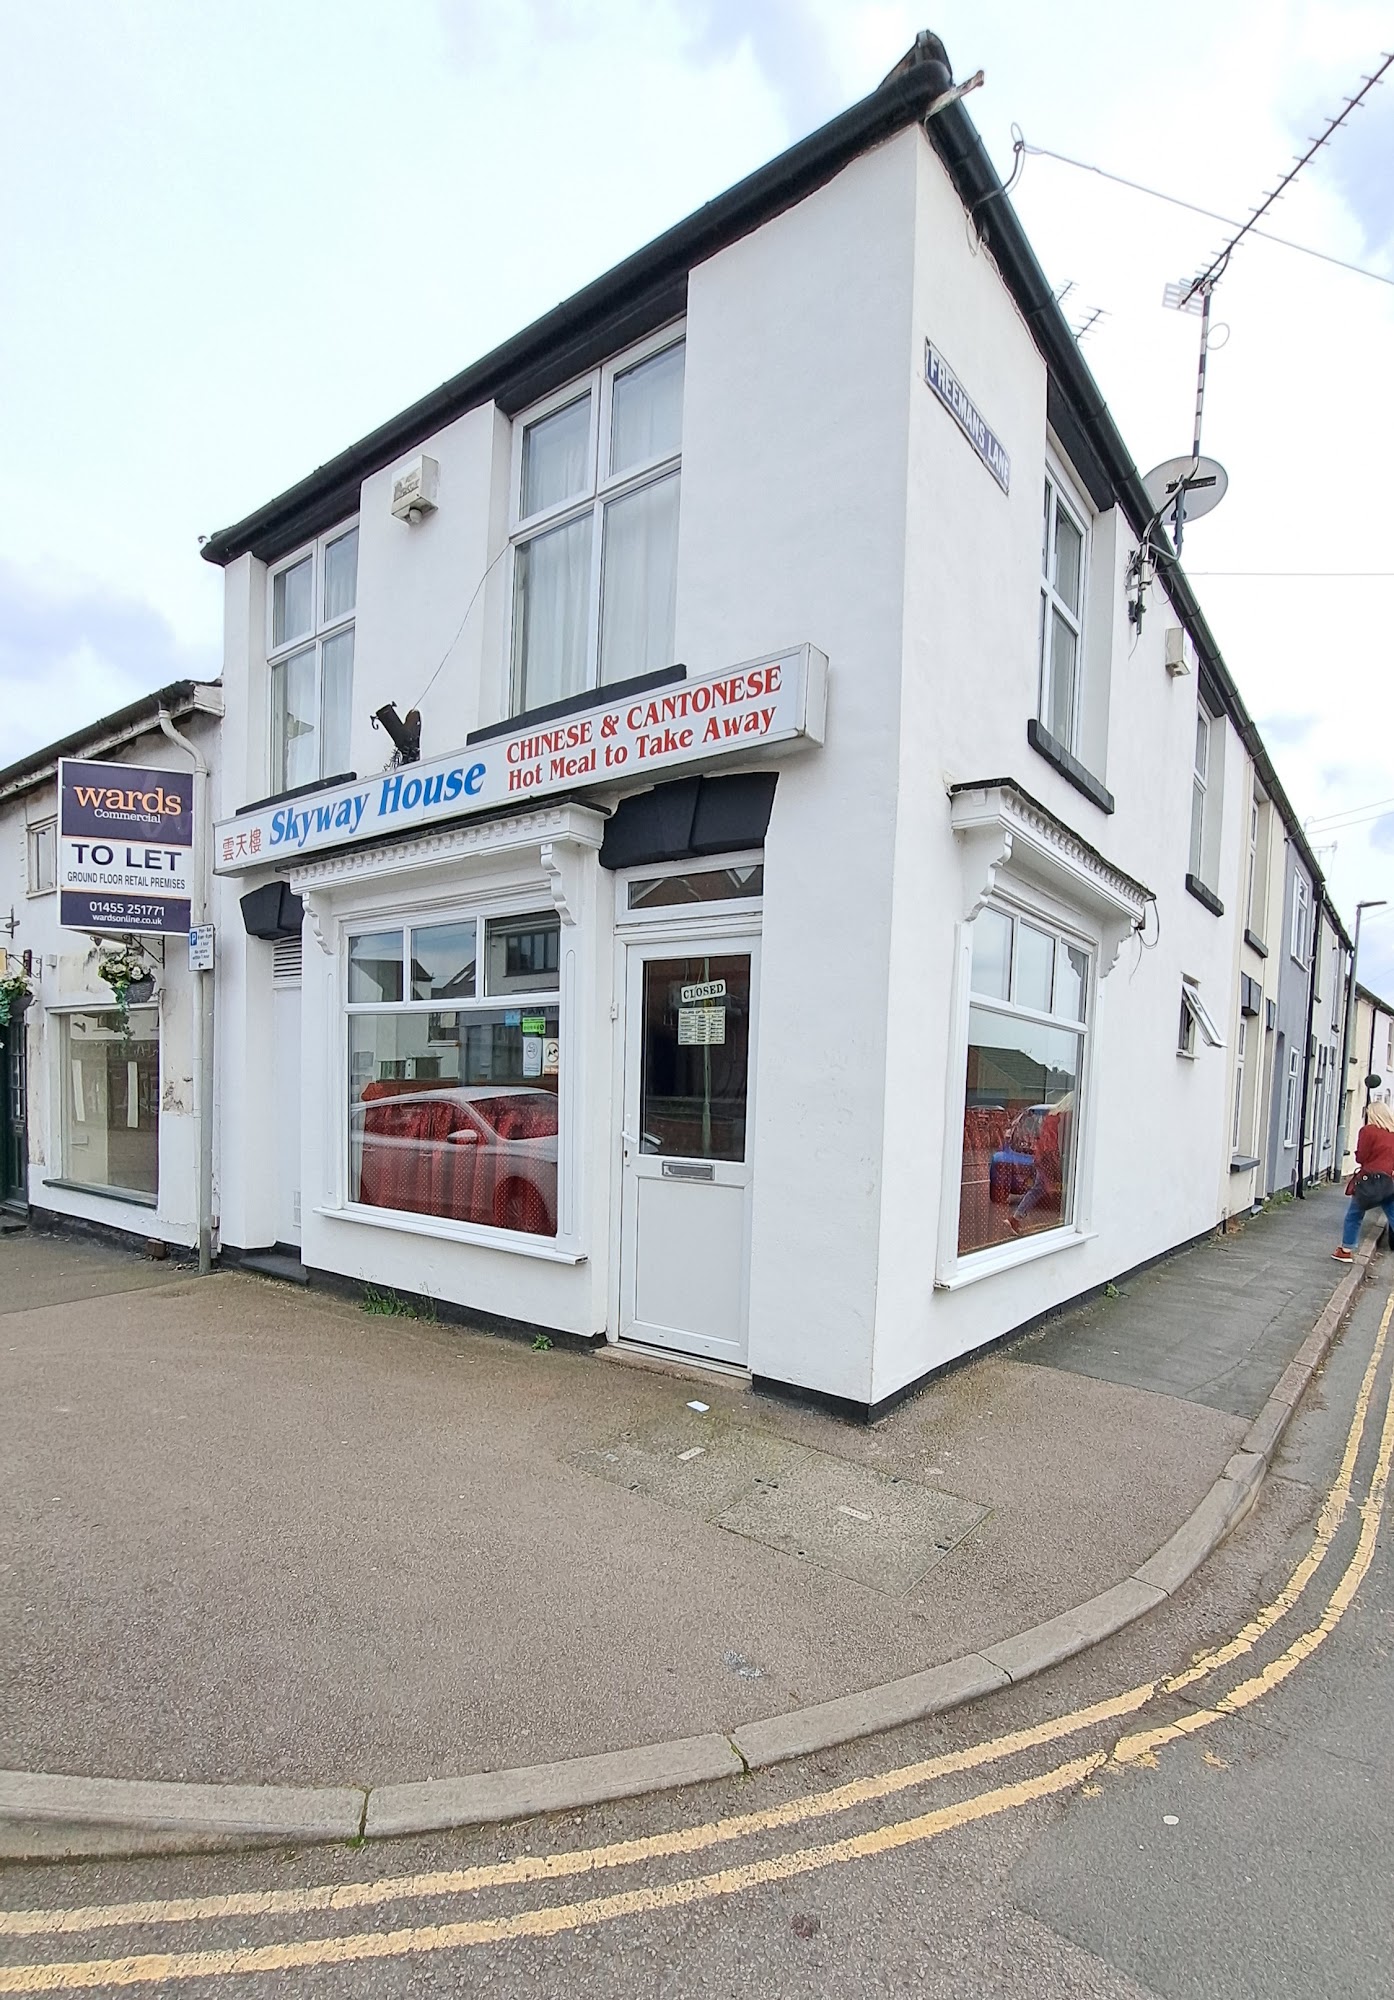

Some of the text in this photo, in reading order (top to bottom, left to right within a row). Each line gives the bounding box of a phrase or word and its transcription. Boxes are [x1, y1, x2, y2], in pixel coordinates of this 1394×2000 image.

[930, 355, 1010, 484] FREEMANS LANE
[506, 665, 782, 764] CHINESE & CANTONESE
[508, 706, 777, 791] Hot Meal to Take Away
[73, 785, 182, 815] wards
[269, 762, 486, 847] Skyway House
[94, 808, 161, 823] Commercial
[71, 843, 182, 871] TO LET
[222, 827, 262, 861] 雲天樓
[67, 871, 185, 889] GROUND FLOOR RETAIL PREMISES
[89, 901, 165, 916] 01455 251771
[92, 914, 163, 925] wardsonline.co.uk
[683, 983, 724, 999] CLOSED
